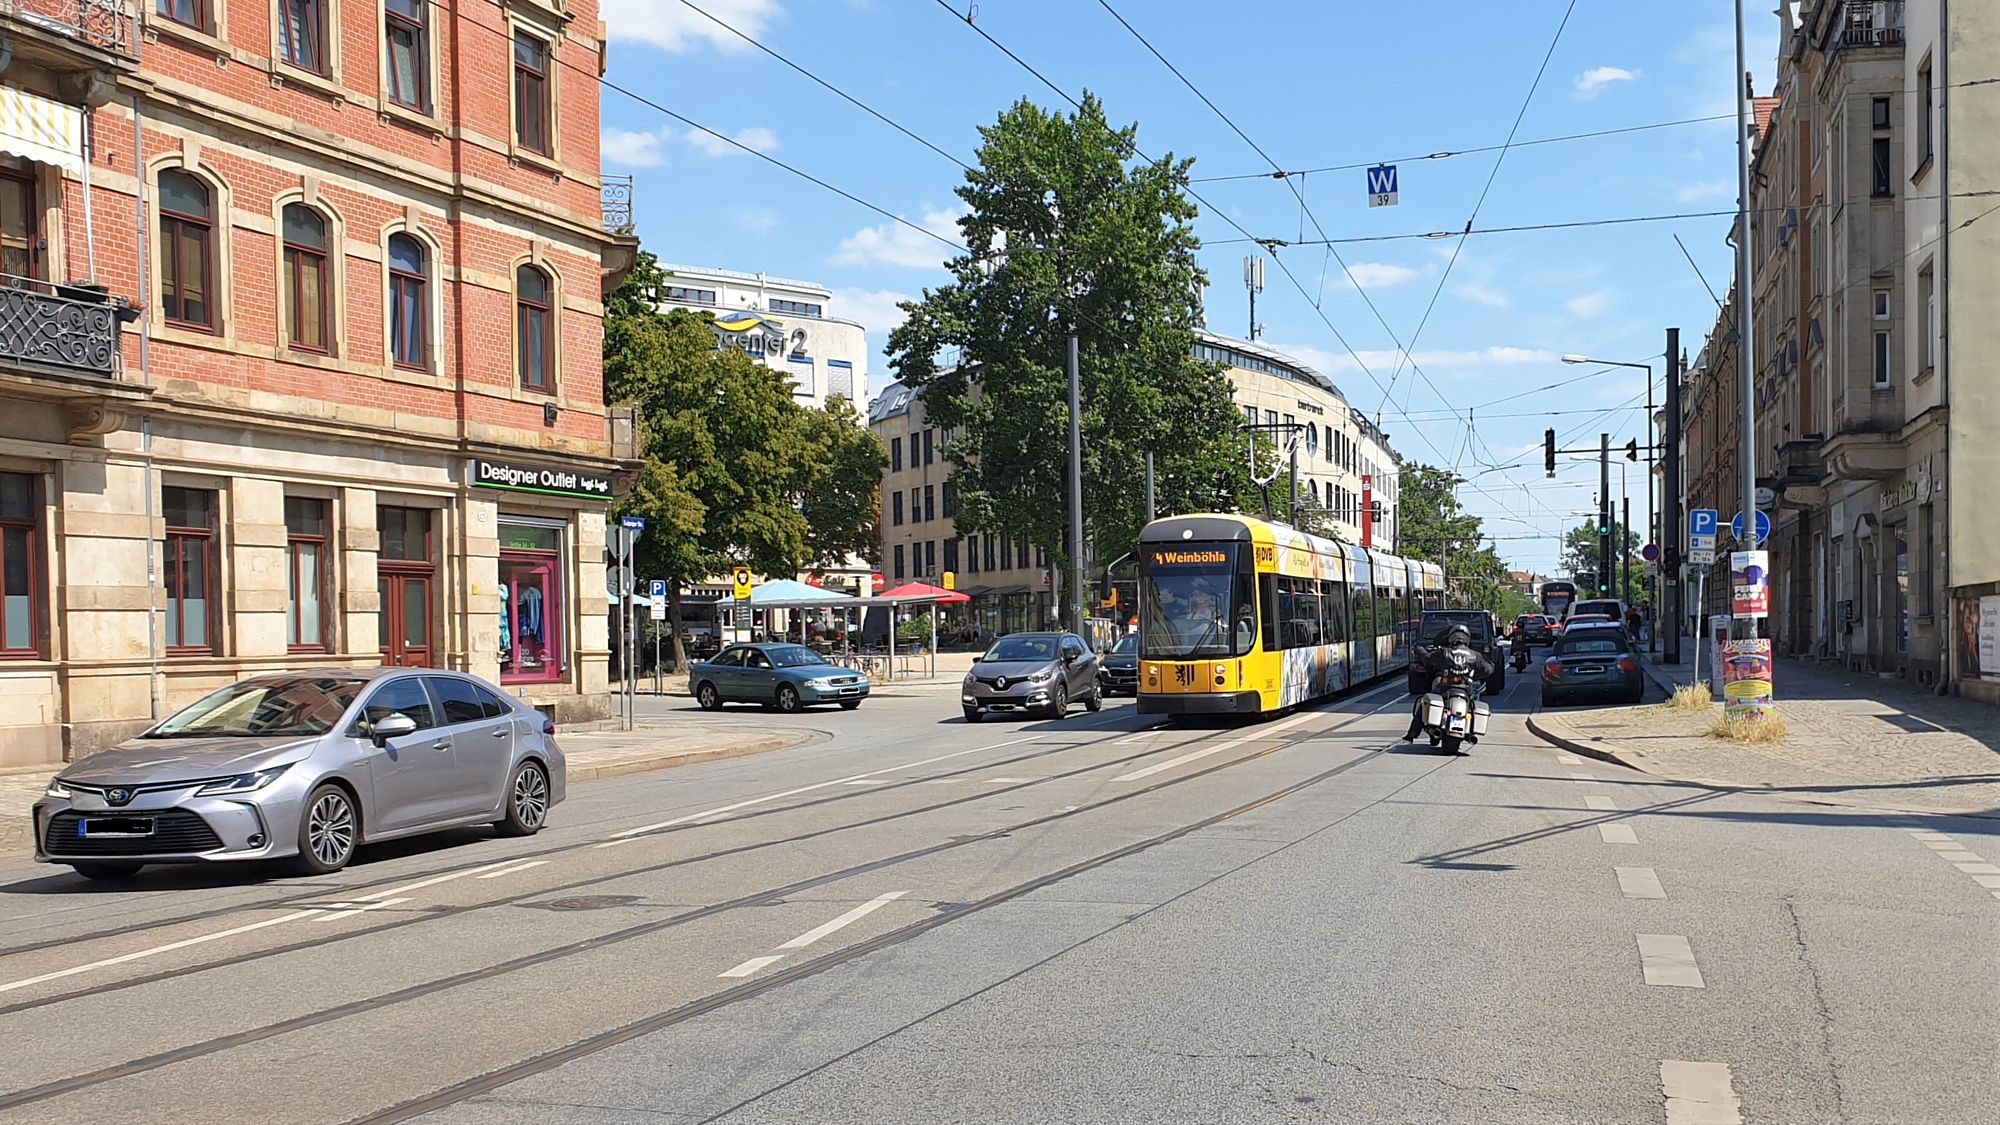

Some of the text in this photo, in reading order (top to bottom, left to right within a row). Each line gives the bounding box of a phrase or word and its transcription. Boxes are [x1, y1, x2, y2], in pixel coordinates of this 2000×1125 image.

[1369, 168, 1395, 193] W
[1377, 194, 1390, 206] 39
[791, 328, 808, 353] 2
[481, 462, 538, 485] Designer
[540, 470, 577, 489] Outlet
[1695, 512, 1711, 532] P
[1165, 551, 1226, 563] Weinböhla
[1261, 547, 1273, 561] DVB
[653, 582, 662, 594] P
